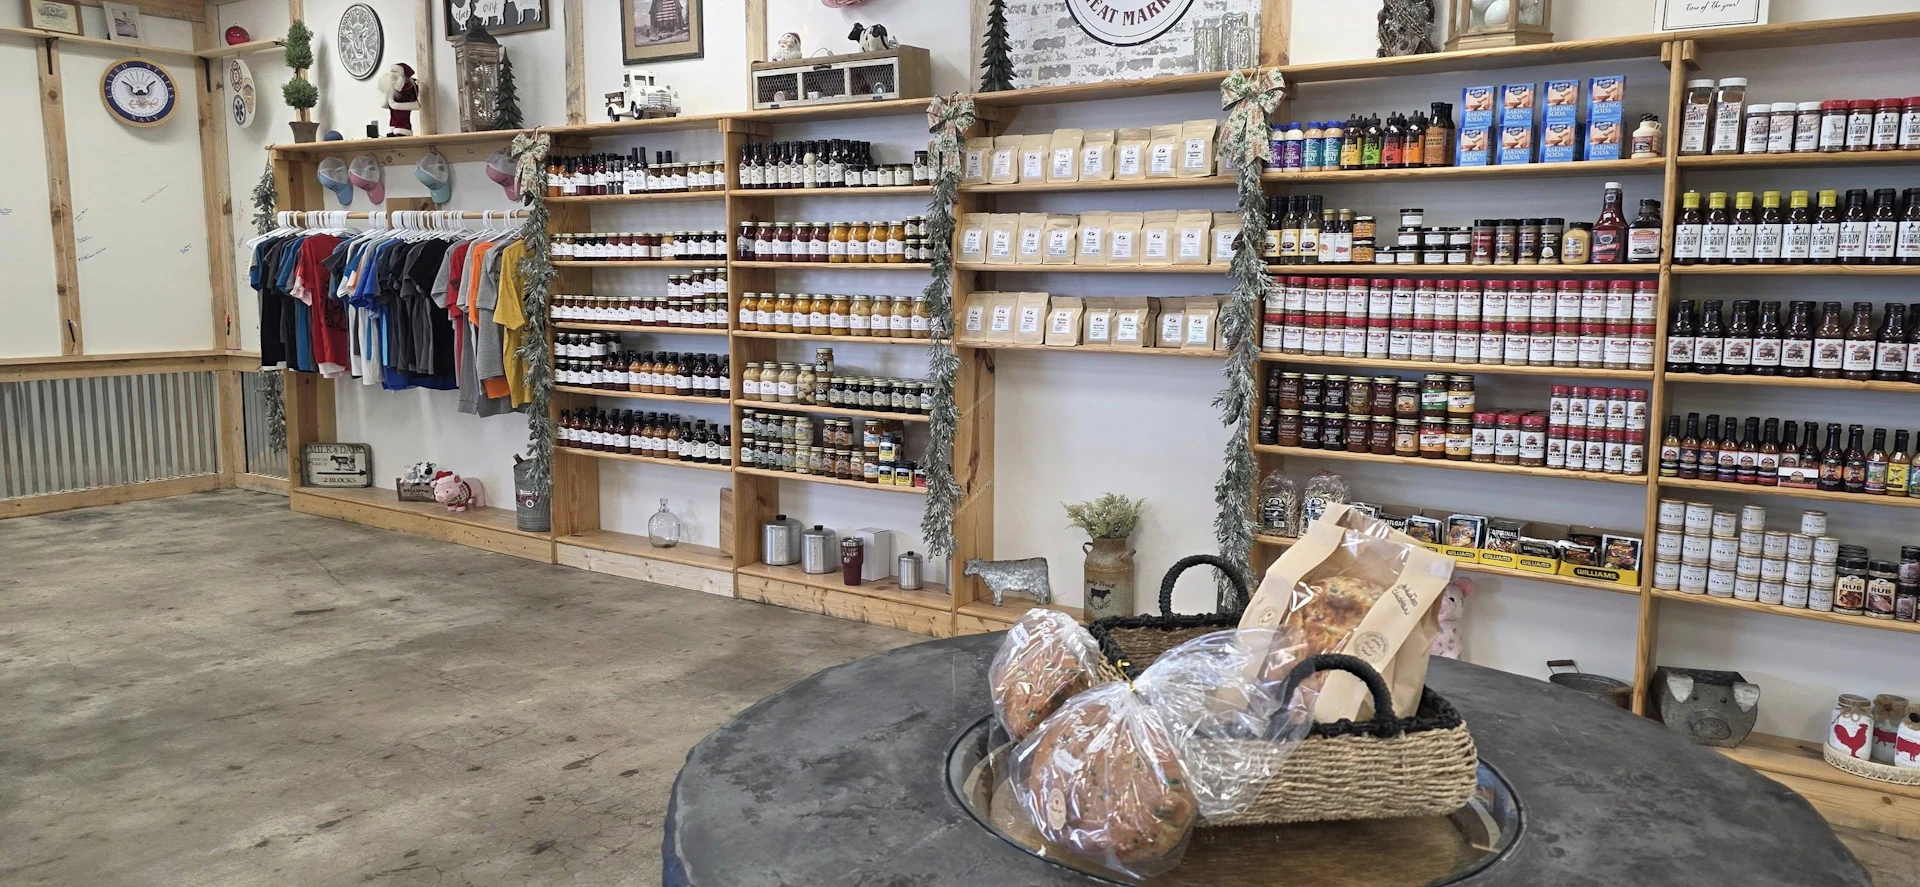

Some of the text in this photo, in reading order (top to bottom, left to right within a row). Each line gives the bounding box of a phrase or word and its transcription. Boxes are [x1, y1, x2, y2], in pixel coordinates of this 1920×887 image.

[1086, 0, 1118, 23] EAT
[105, 64, 175, 98] UNITED STATES
[1492, 529, 1518, 537] ORIGINAL
[1484, 554, 1511, 562] WILLIAMS
[1577, 569, 1617, 579] WILLIAMS
